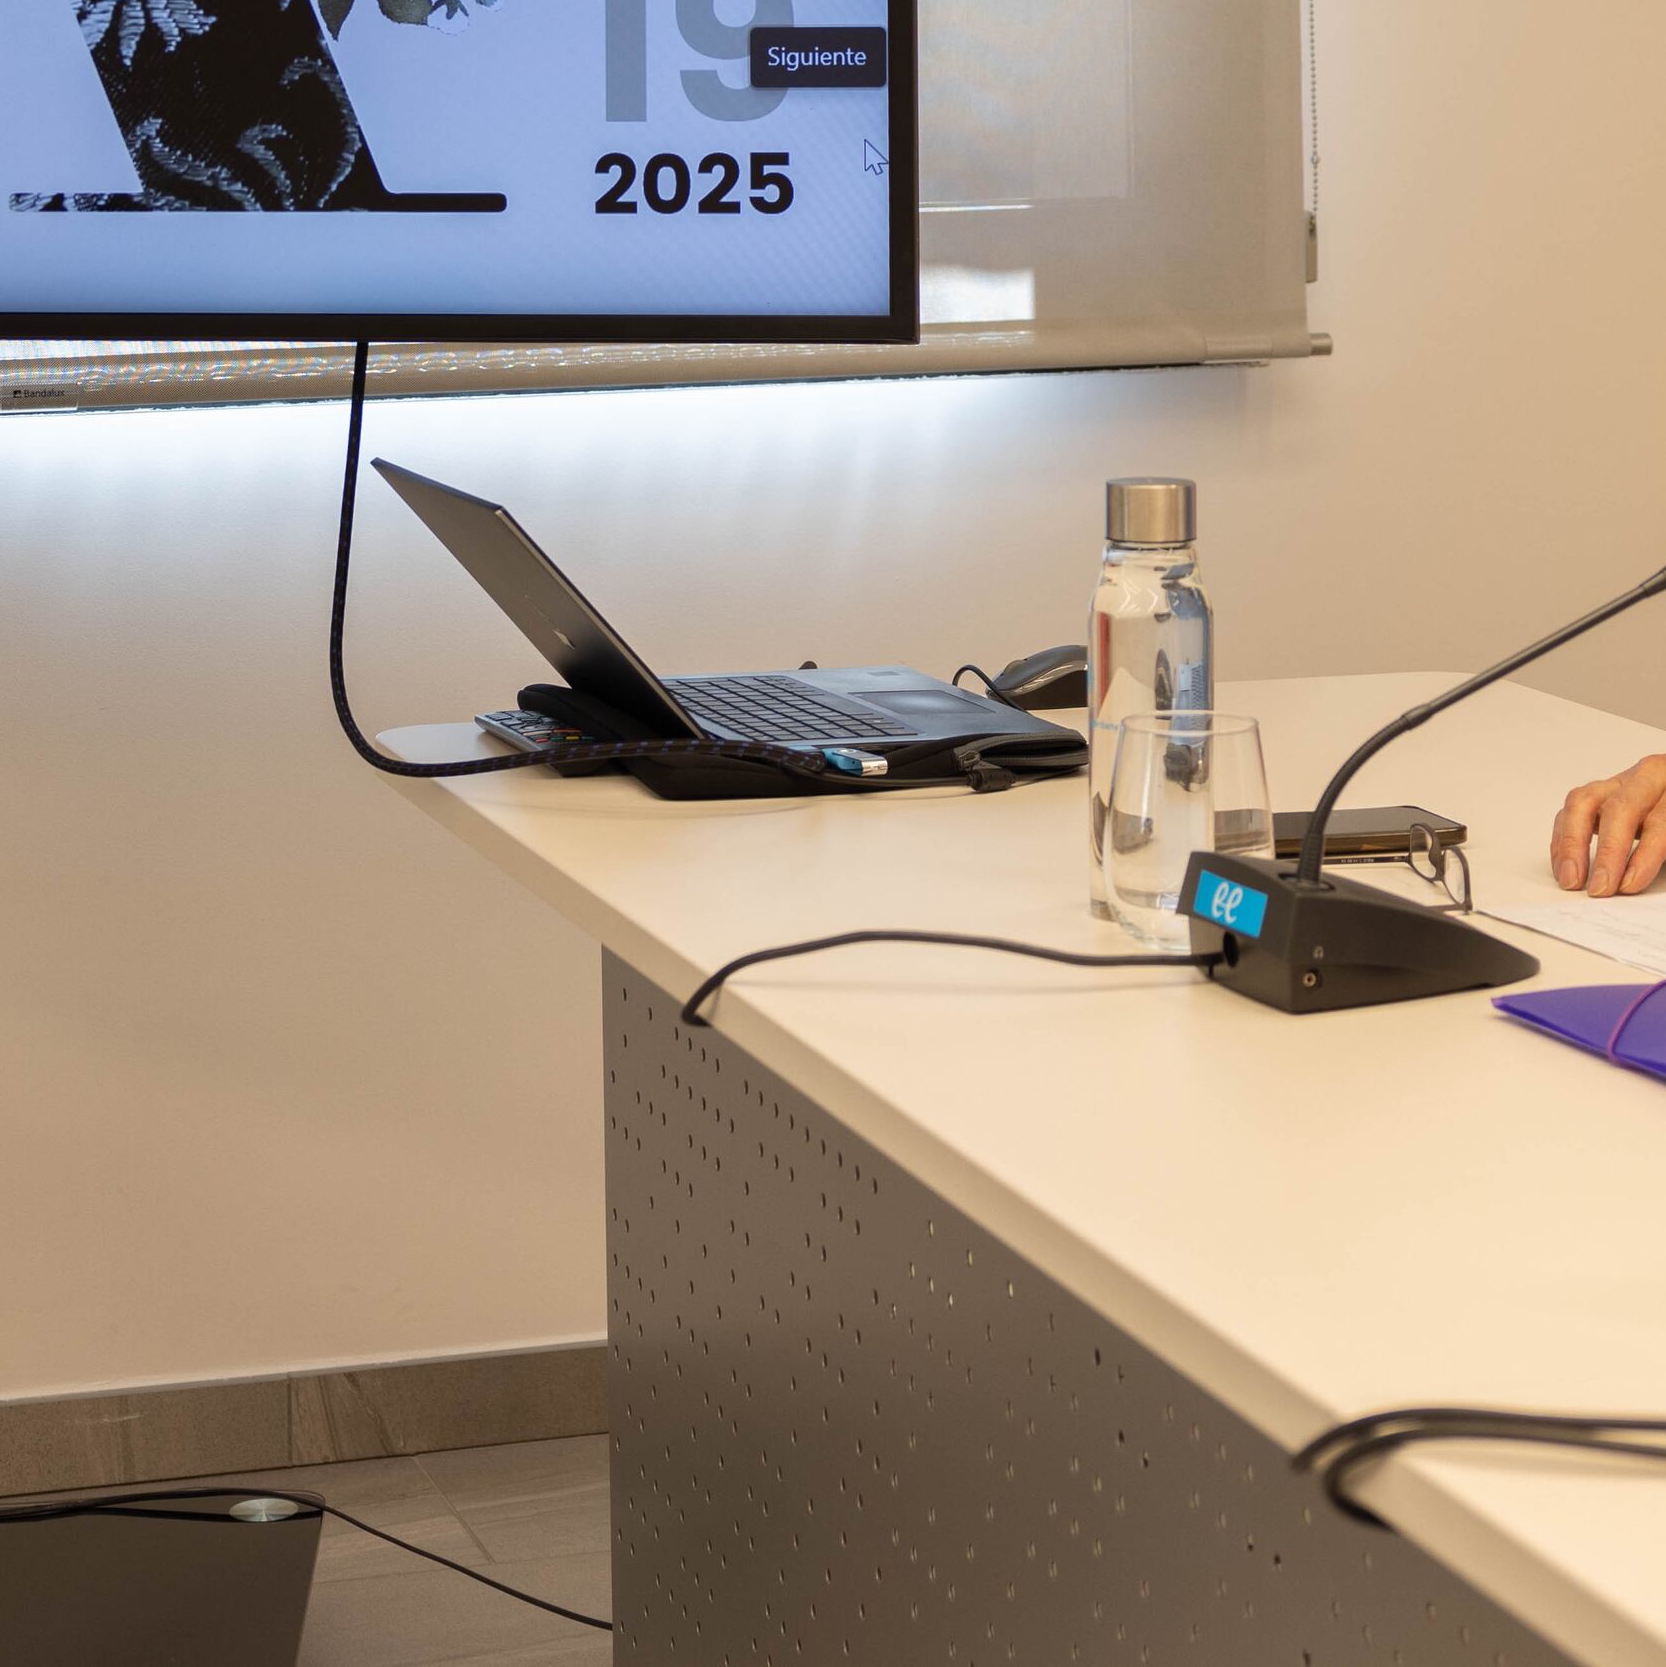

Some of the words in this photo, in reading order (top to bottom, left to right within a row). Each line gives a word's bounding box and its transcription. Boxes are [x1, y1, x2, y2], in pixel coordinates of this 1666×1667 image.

[767, 45, 868, 72] Siguiente
[594, 151, 795, 215] 2025
[23, 388, 65, 398] Bandalux
